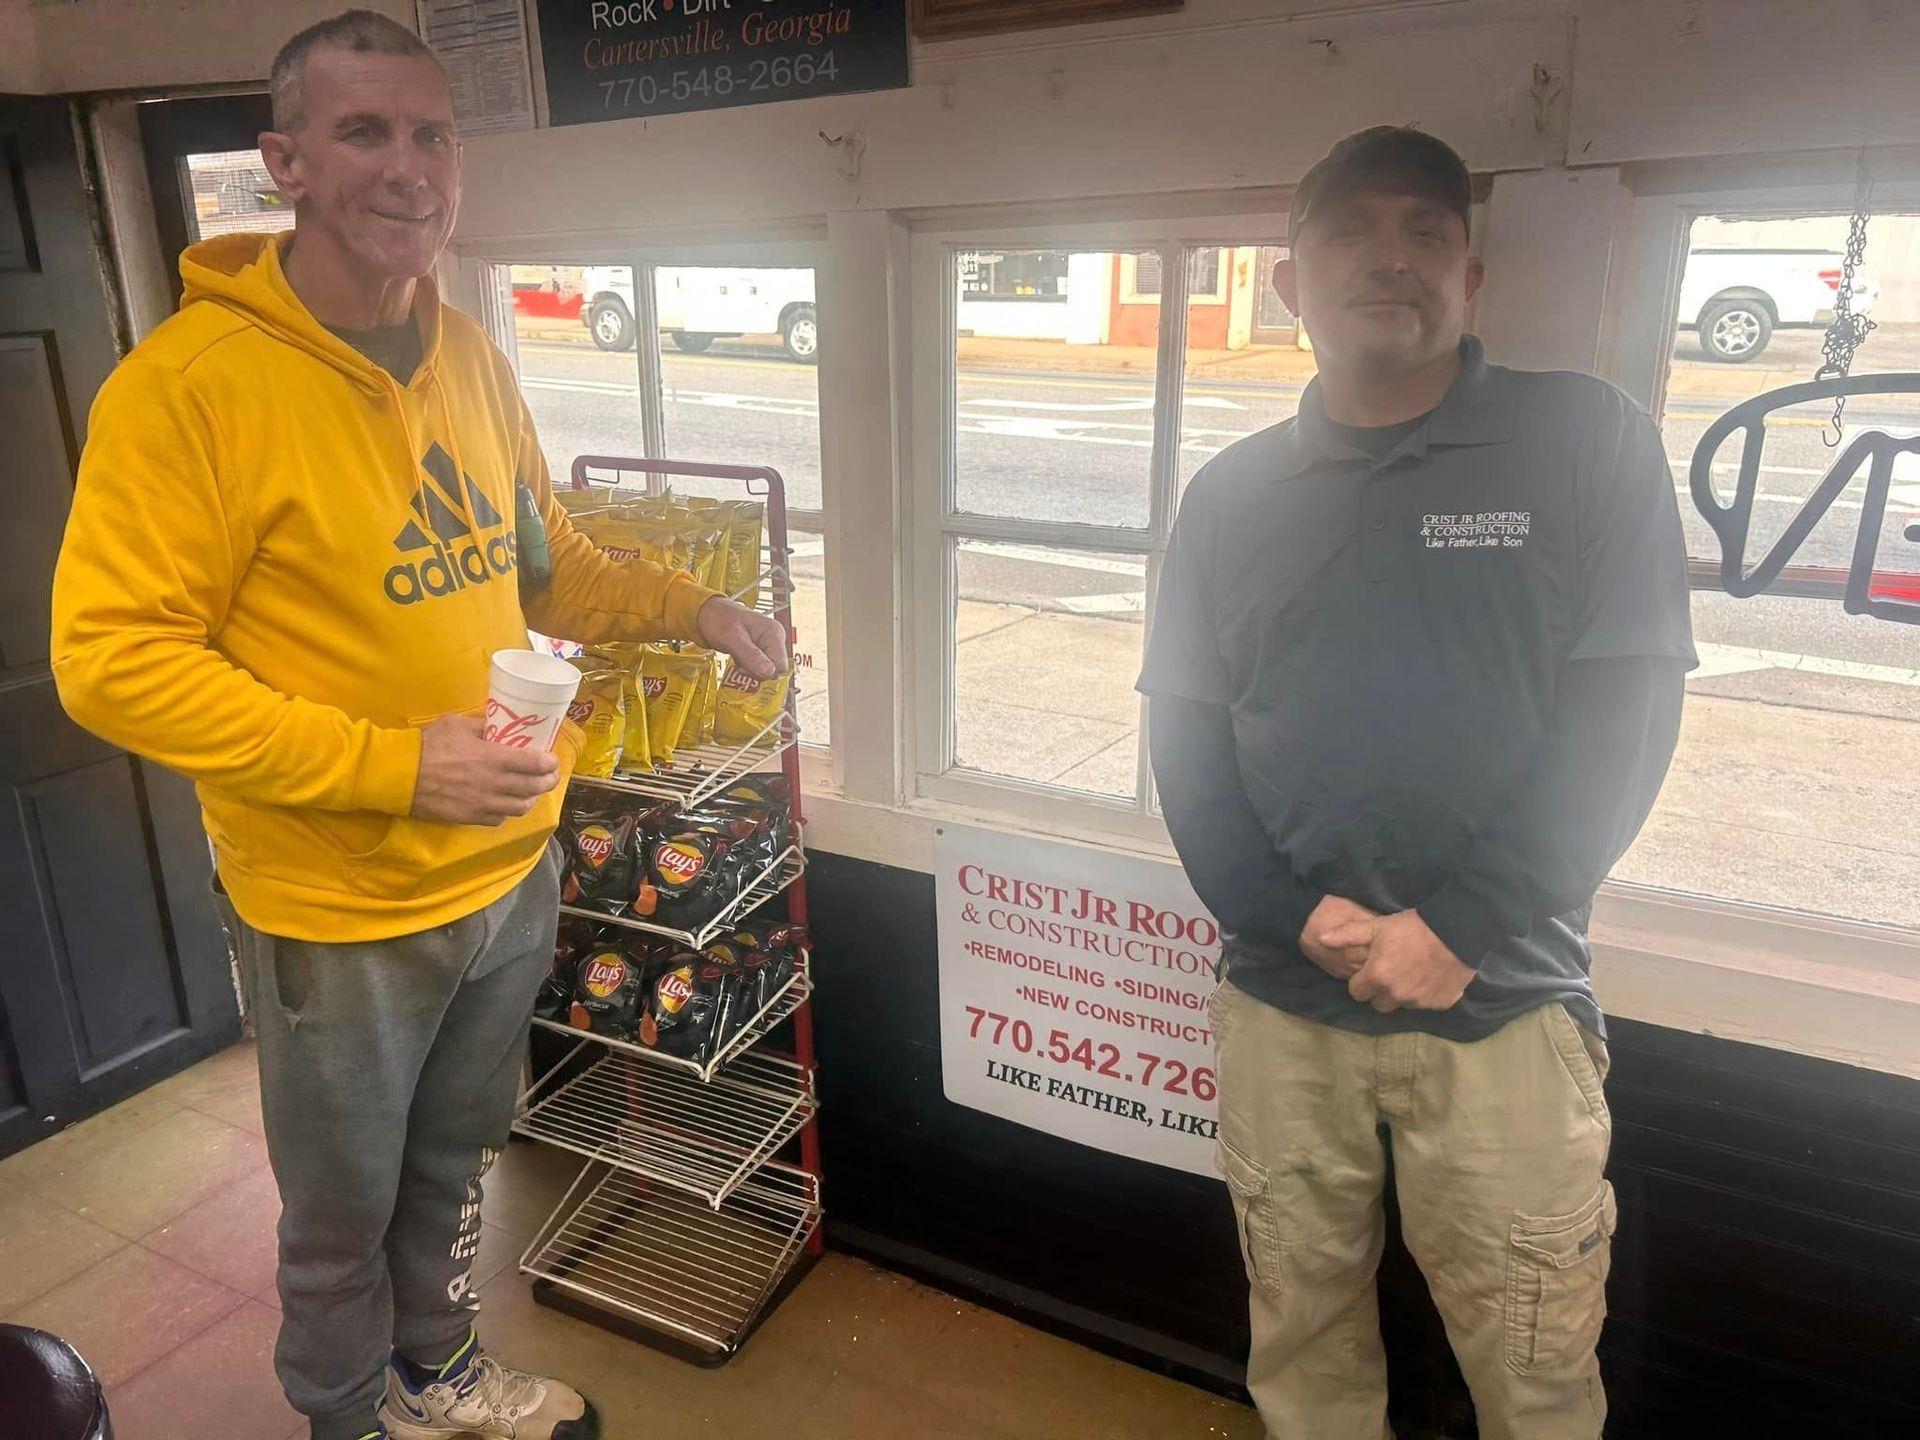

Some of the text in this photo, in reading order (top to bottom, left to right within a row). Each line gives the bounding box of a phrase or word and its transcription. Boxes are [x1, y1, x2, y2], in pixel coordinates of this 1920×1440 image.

[583, 3, 851, 70] Cartersville, Georgia
[592, 0, 657, 30] Rock
[600, 50, 839, 109] 770-548-2664
[1420, 524, 1530, 536] & CONSTRUCTION
[1422, 511, 1531, 524] CRIST JR ROOFING
[1426, 538, 1445, 548] Like
[1480, 535, 1499, 546] Like
[1503, 536, 1523, 547] Son
[384, 530, 517, 605] adidas
[659, 848, 700, 873] Lay's
[958, 864, 1217, 946] CRIST JR ROO
[961, 902, 1217, 976] & CONSTRUCTION
[1123, 979, 1210, 1011] SIDING/
[965, 1005, 1217, 1101] 770.542.726
[986, 1060, 1042, 1092] LIKE
[1046, 1077, 1154, 1126] FATHER,
